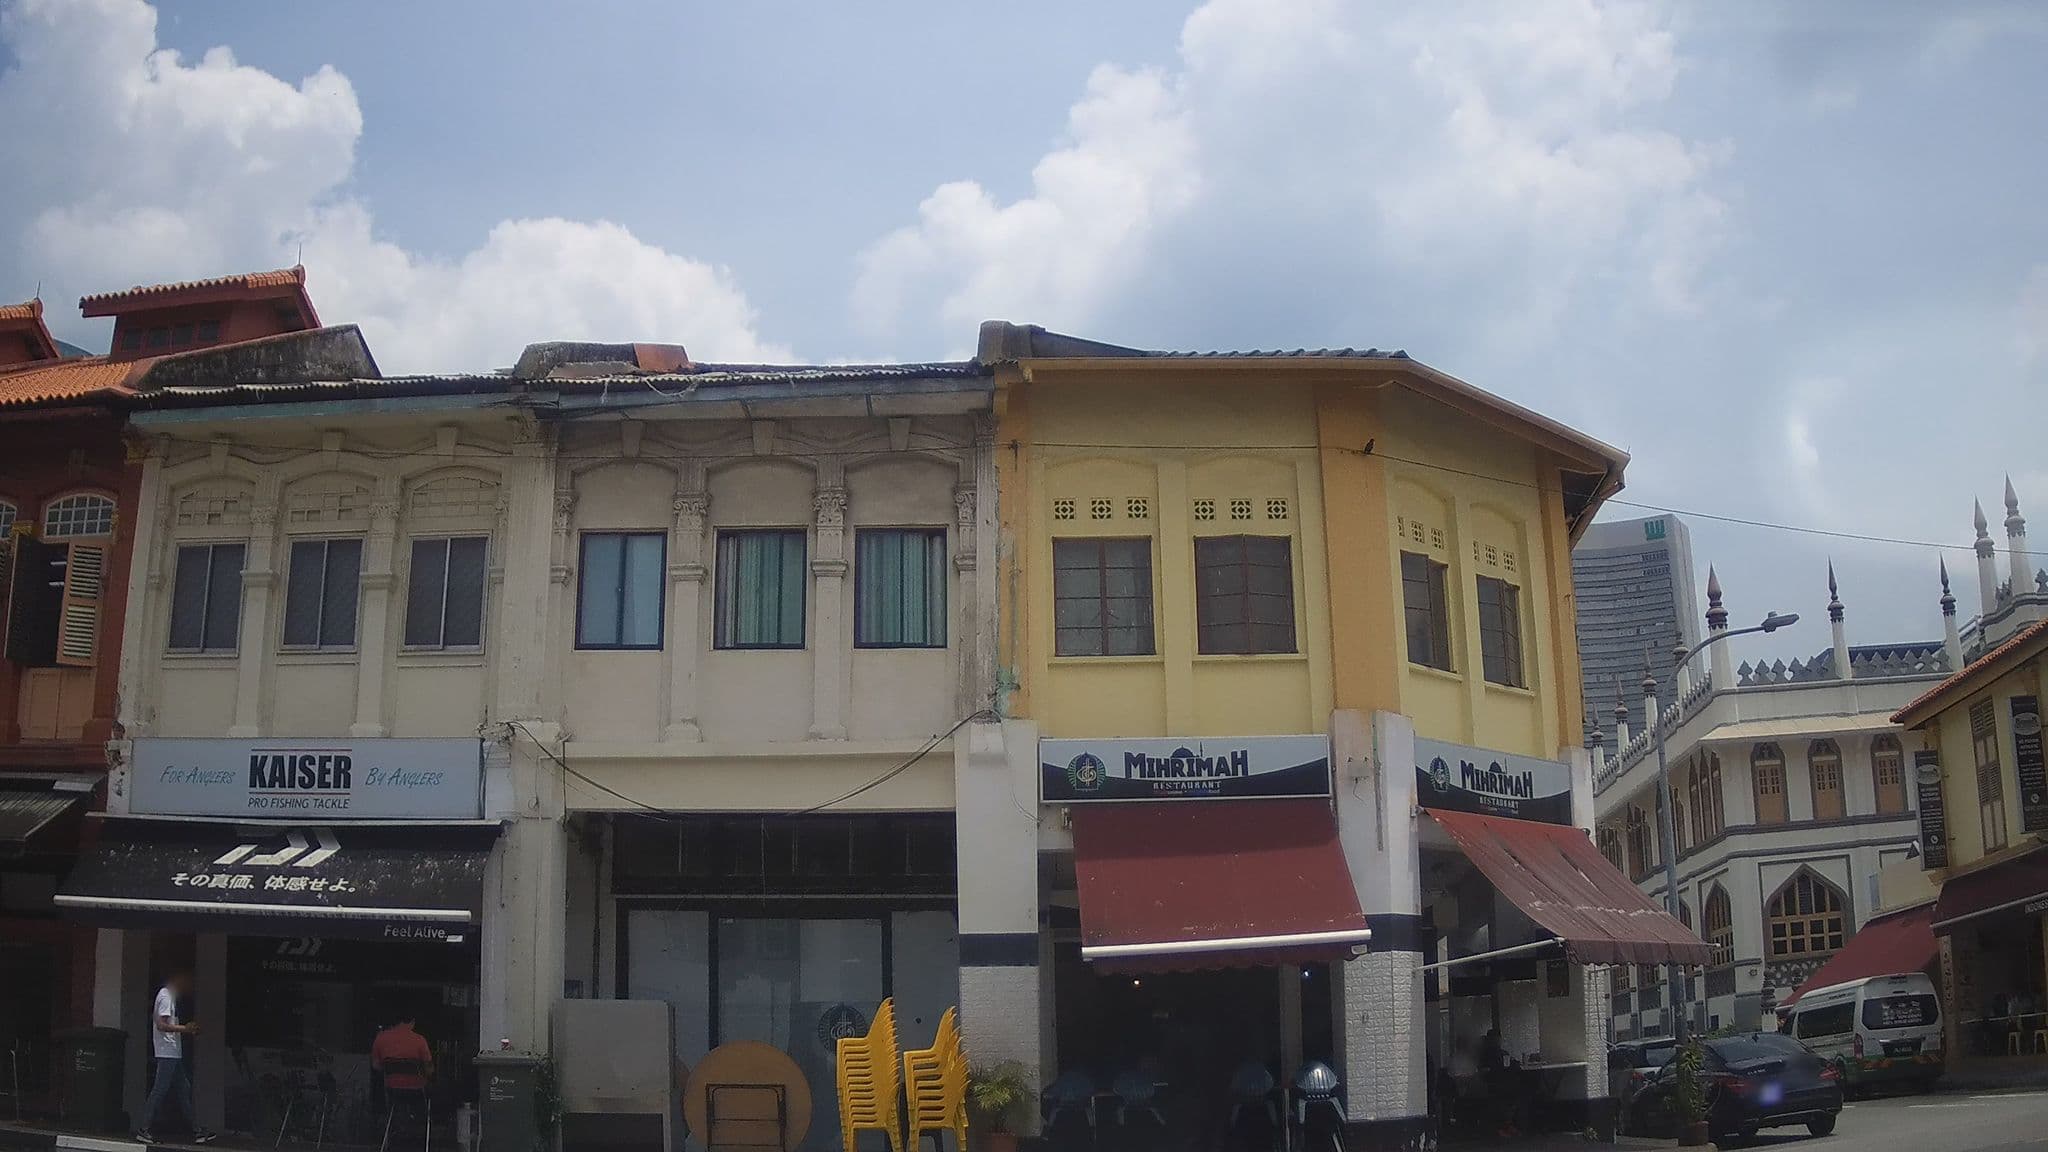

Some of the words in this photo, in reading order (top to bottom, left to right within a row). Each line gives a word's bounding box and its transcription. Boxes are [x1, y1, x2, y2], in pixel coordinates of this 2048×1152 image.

[249, 754, 352, 790] KAISER
[1124, 749, 1249, 778] MIHRIMAH
[1152, 780, 1223, 790] RESTAURANT
[1460, 759, 1534, 799] MIHRIMAH
[248, 797, 269, 810] PRO
[270, 797, 310, 810] FISHING
[313, 797, 351, 810] TACKLE
[384, 924, 411, 938] Feel
